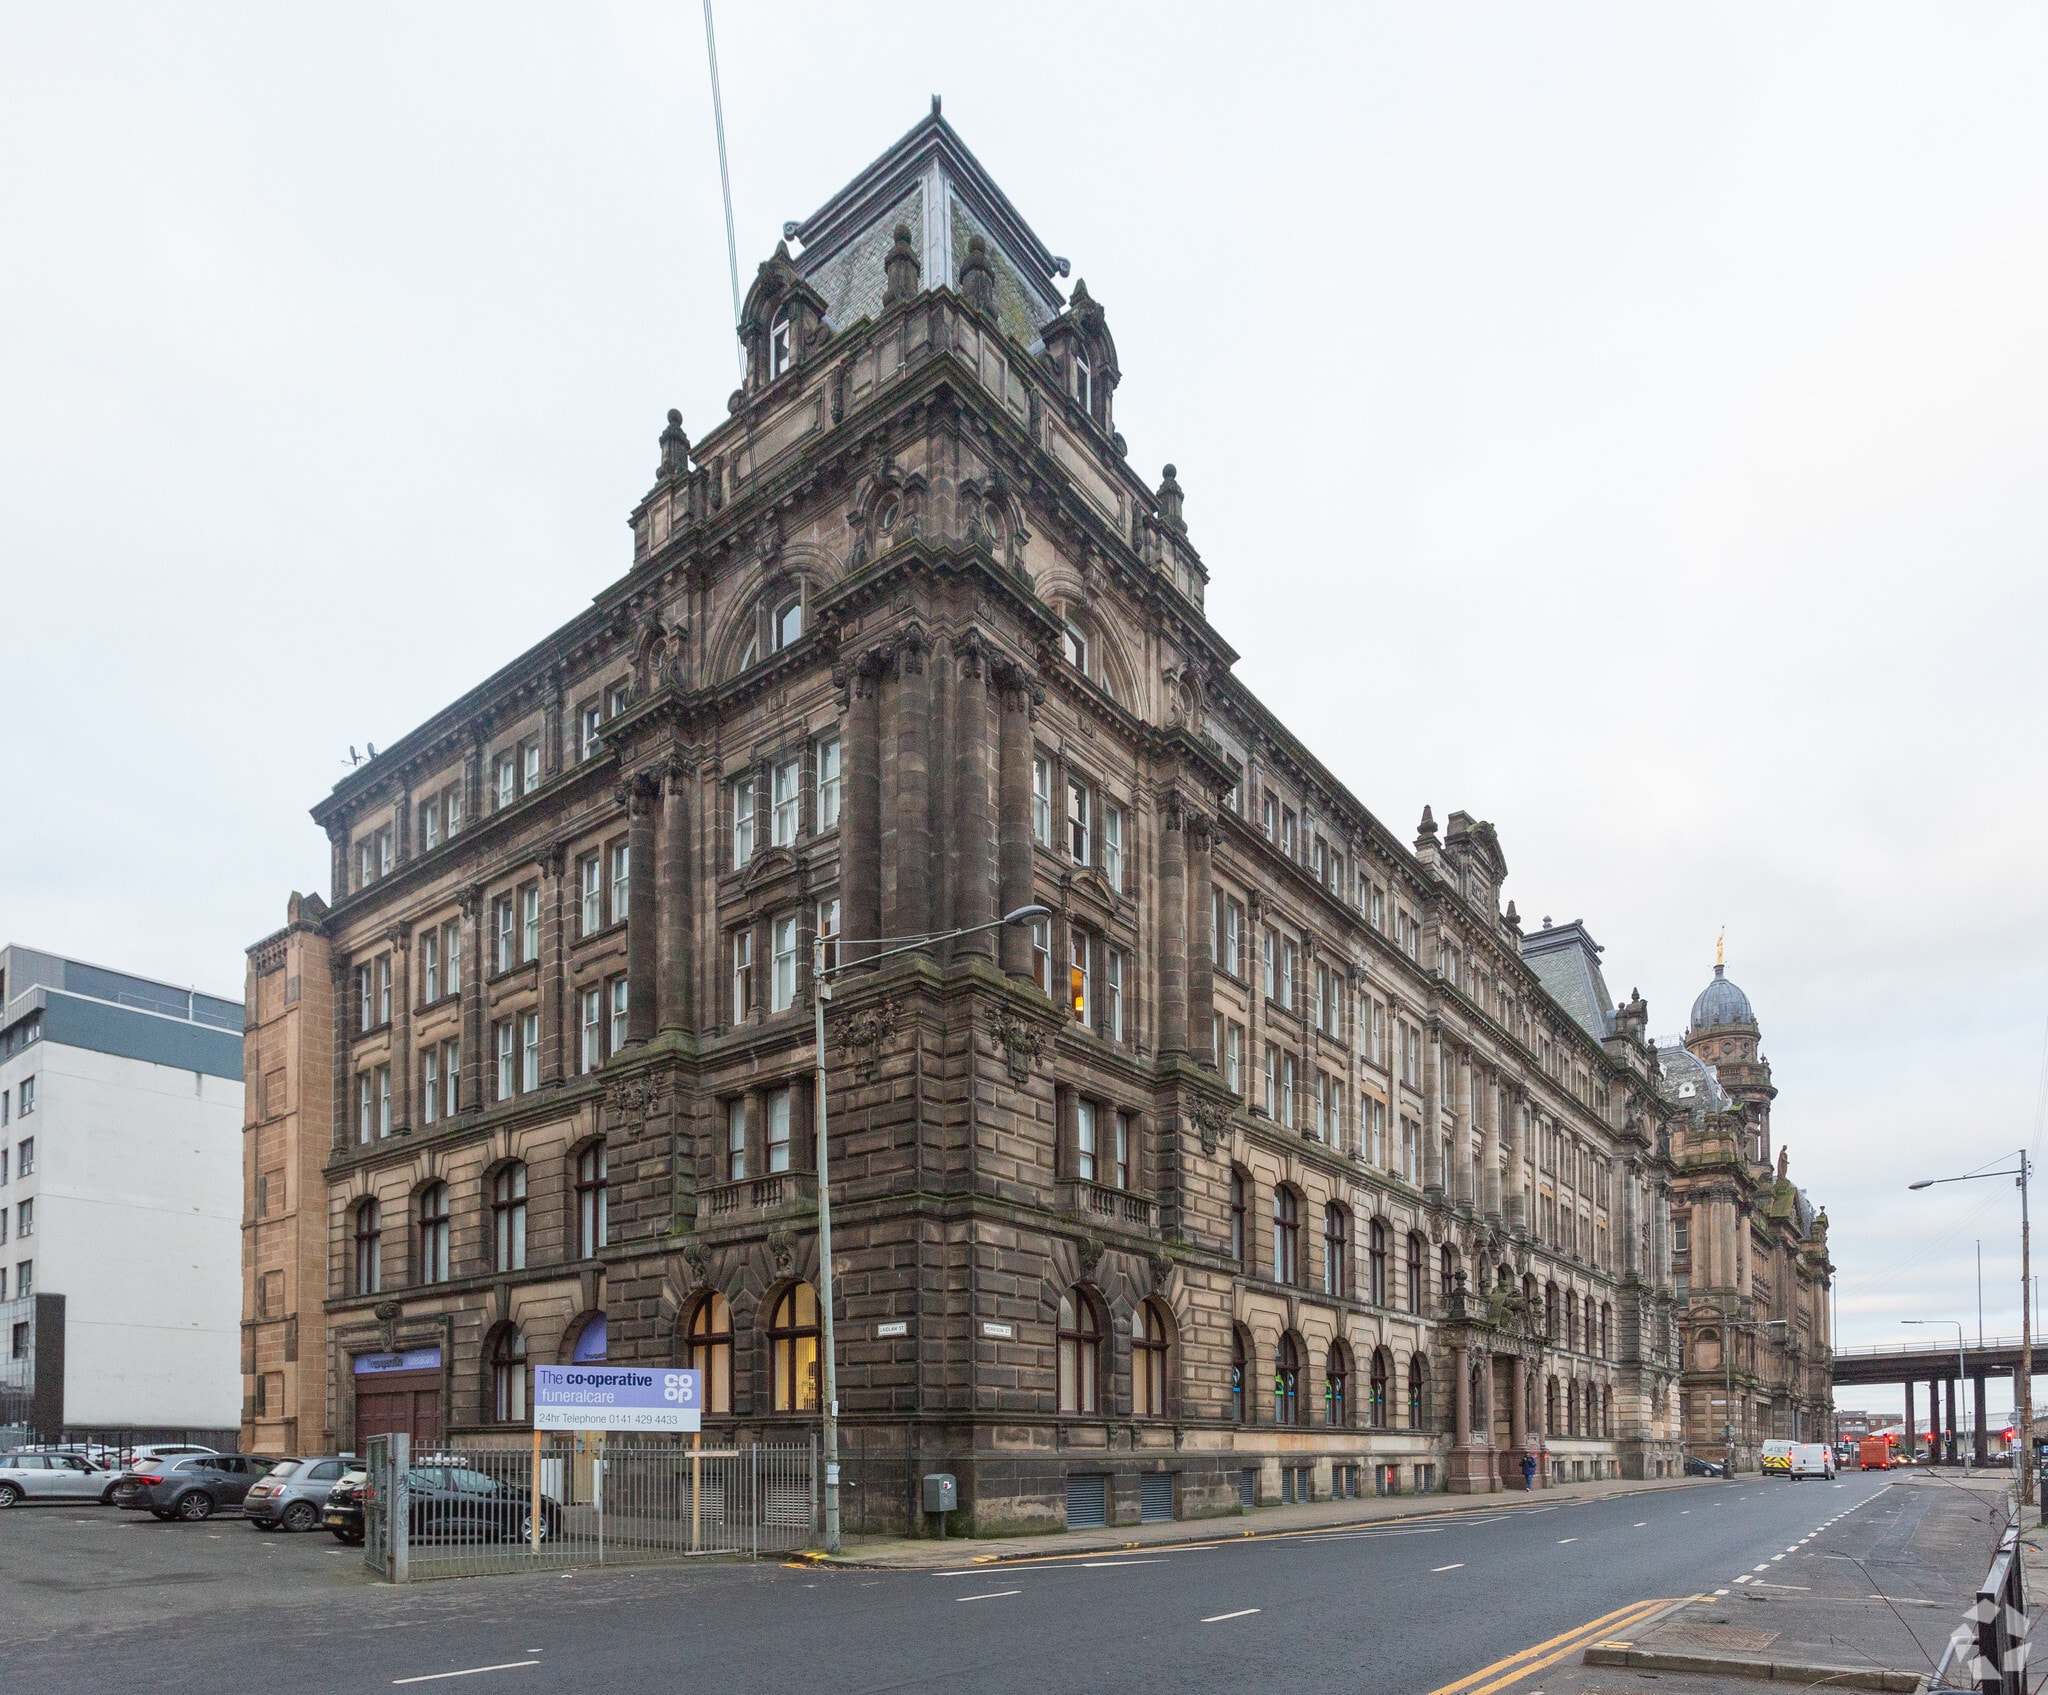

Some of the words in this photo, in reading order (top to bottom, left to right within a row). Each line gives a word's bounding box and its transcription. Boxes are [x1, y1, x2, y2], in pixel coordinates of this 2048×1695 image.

[540, 1370, 563, 1385] The
[566, 1373, 653, 1388] co-operative
[542, 1388, 615, 1403] funeralcare
[539, 1413, 560, 1424] 24hr
[563, 1414, 607, 1425] Telephone
[609, 1414, 631, 1424] 0141
[635, 1415, 652, 1424] 429
[655, 1415, 678, 1425] 4433
